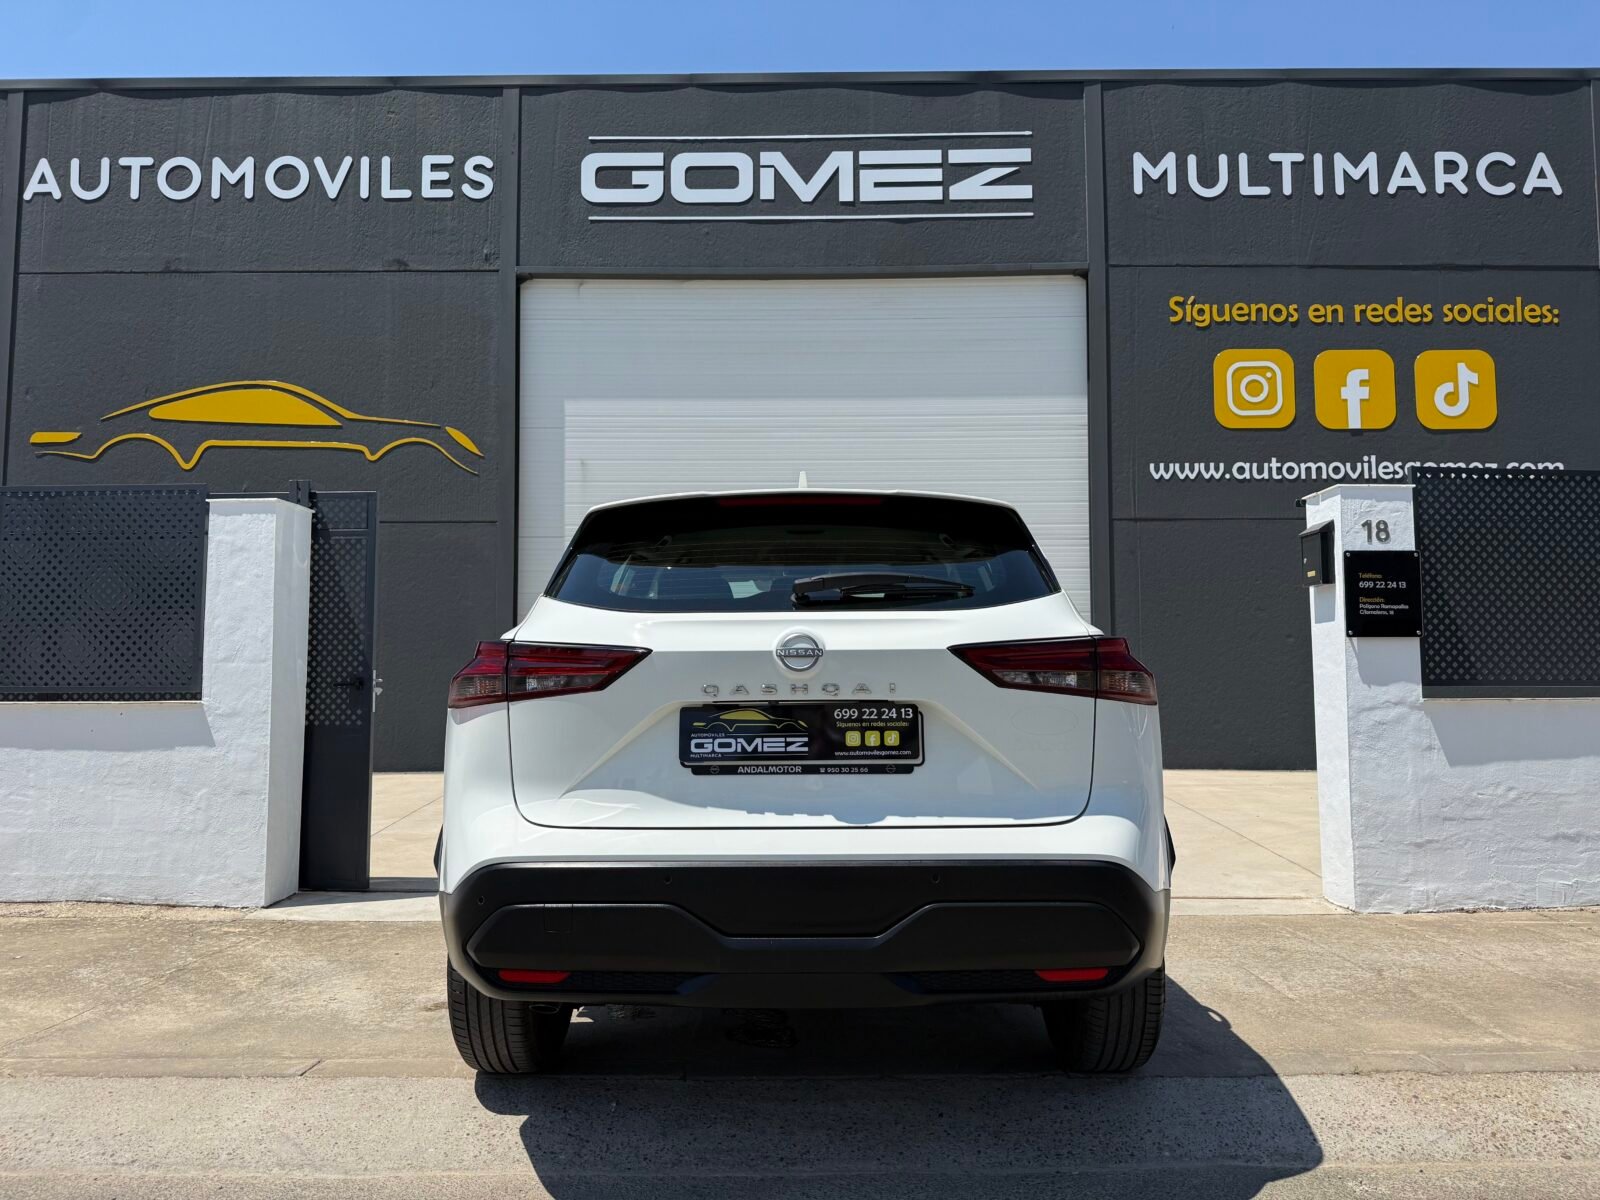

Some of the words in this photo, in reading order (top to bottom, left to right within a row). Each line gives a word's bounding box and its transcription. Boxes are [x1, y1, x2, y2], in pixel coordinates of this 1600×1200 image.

[22, 155, 496, 201] AUTOMOVILES
[580, 147, 1034, 205] GOMEZ
[1132, 150, 1563, 198] MULTIMARCA
[1168, 295, 1299, 328] Síguenos
[1307, 304, 1344, 324] en
[1354, 297, 1433, 323] redes
[1443, 297, 1560, 324] sociales:
[1149, 455, 1564, 480] www.automoviles
[1361, 519, 1391, 545] 18
[1359, 580, 1374, 588] 699
[1375, 580, 1386, 589] 22
[1386, 580, 1397, 589] 24
[1398, 580, 1407, 589] 13
[701, 682, 897, 697] QASHQAI
[834, 708, 858, 720] 699
[861, 708, 878, 719] 22
[881, 708, 898, 719] 24
[900, 708, 913, 719] 13
[690, 737, 809, 753] GOMEZ
[737, 765, 802, 774] ANDALMOTOR
